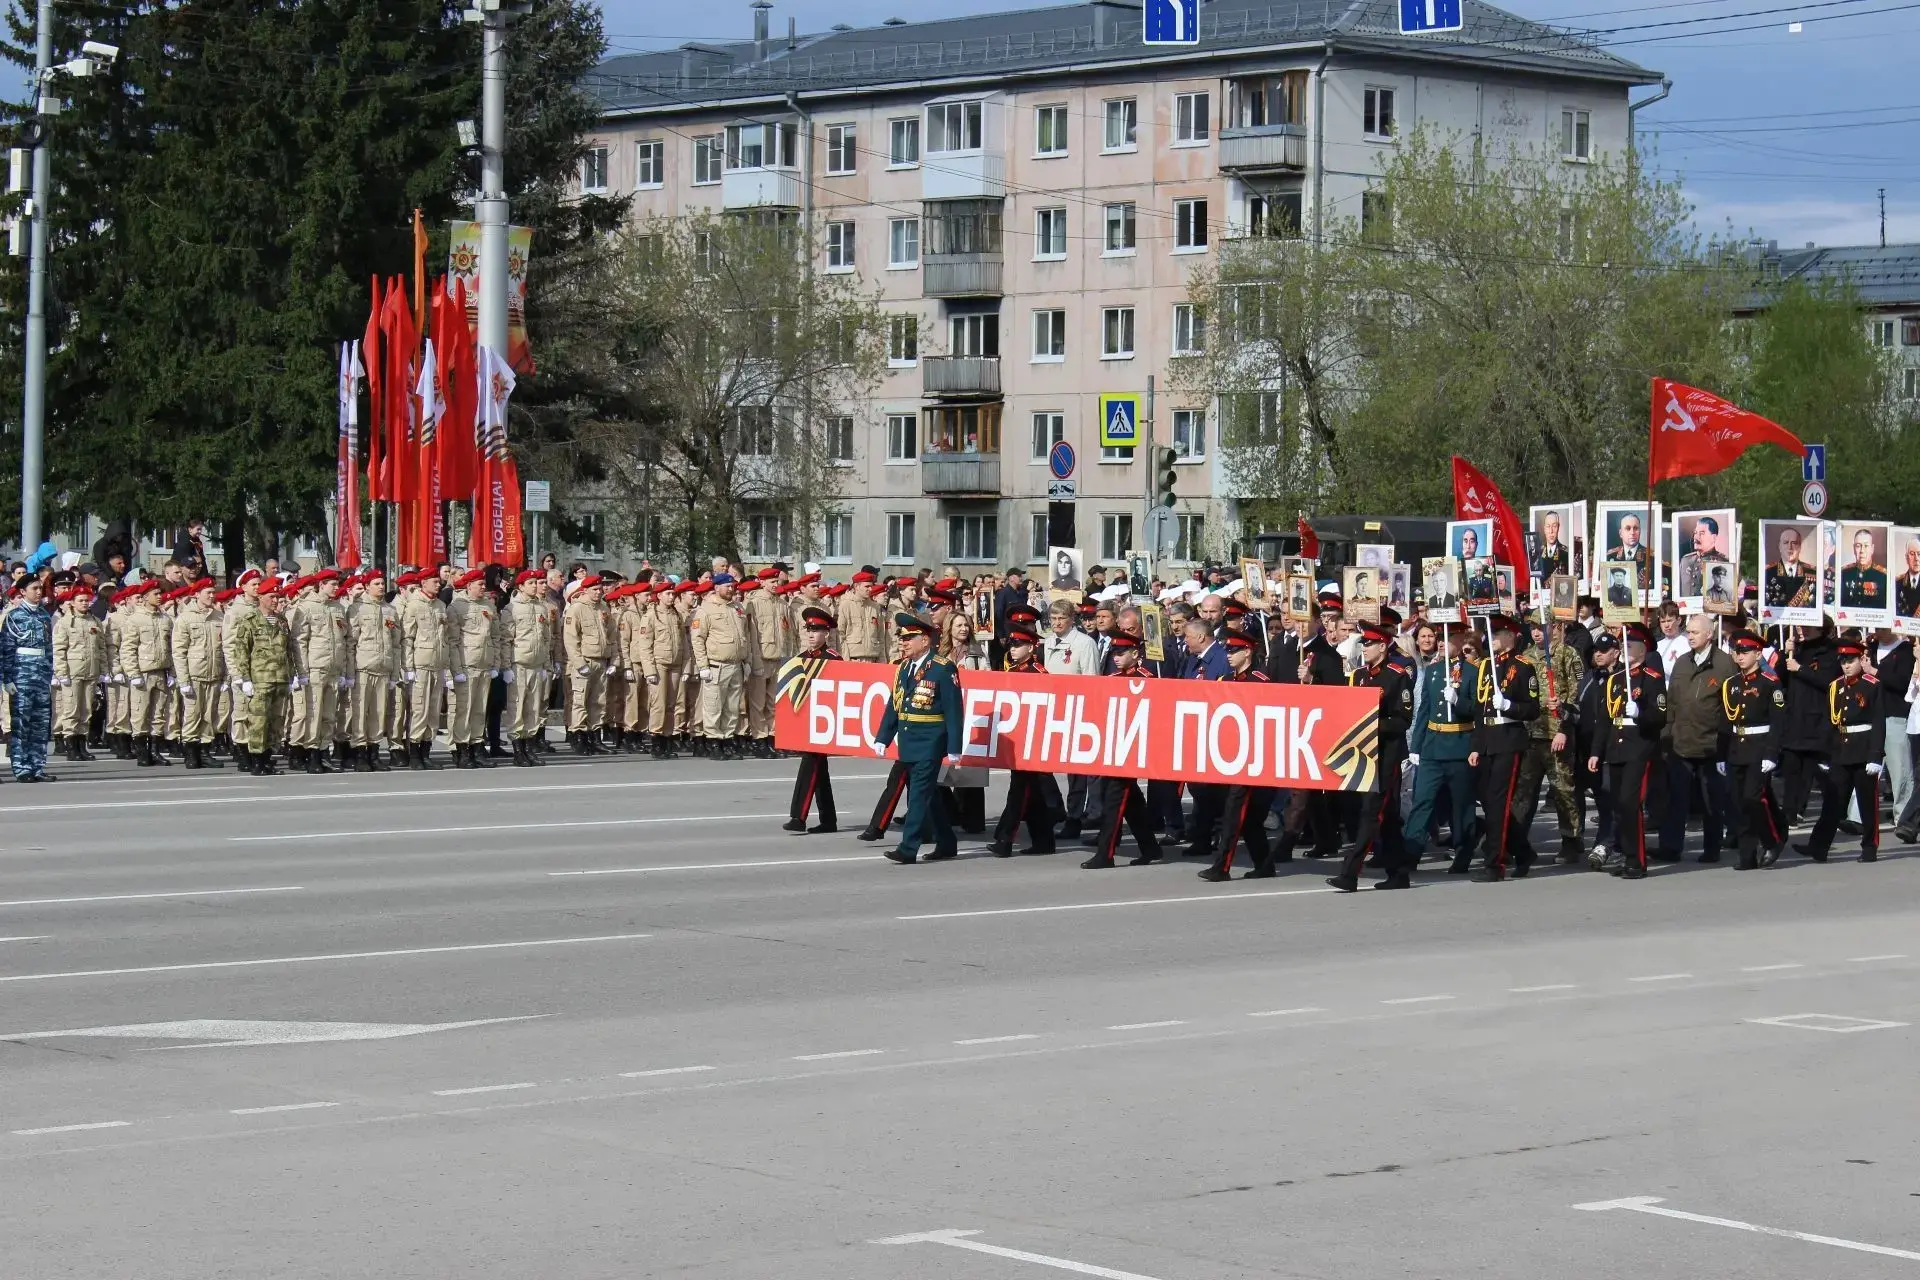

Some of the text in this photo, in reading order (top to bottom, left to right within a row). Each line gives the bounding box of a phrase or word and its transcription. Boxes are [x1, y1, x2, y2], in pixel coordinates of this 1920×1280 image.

[492, 481, 504, 553] ПОБЕДА!
[1808, 492, 1821, 506] 40
[505, 515, 517, 553] 1941-1945
[809, 679, 1323, 780] БЕСЕРТНЫЙ ПОЛК
